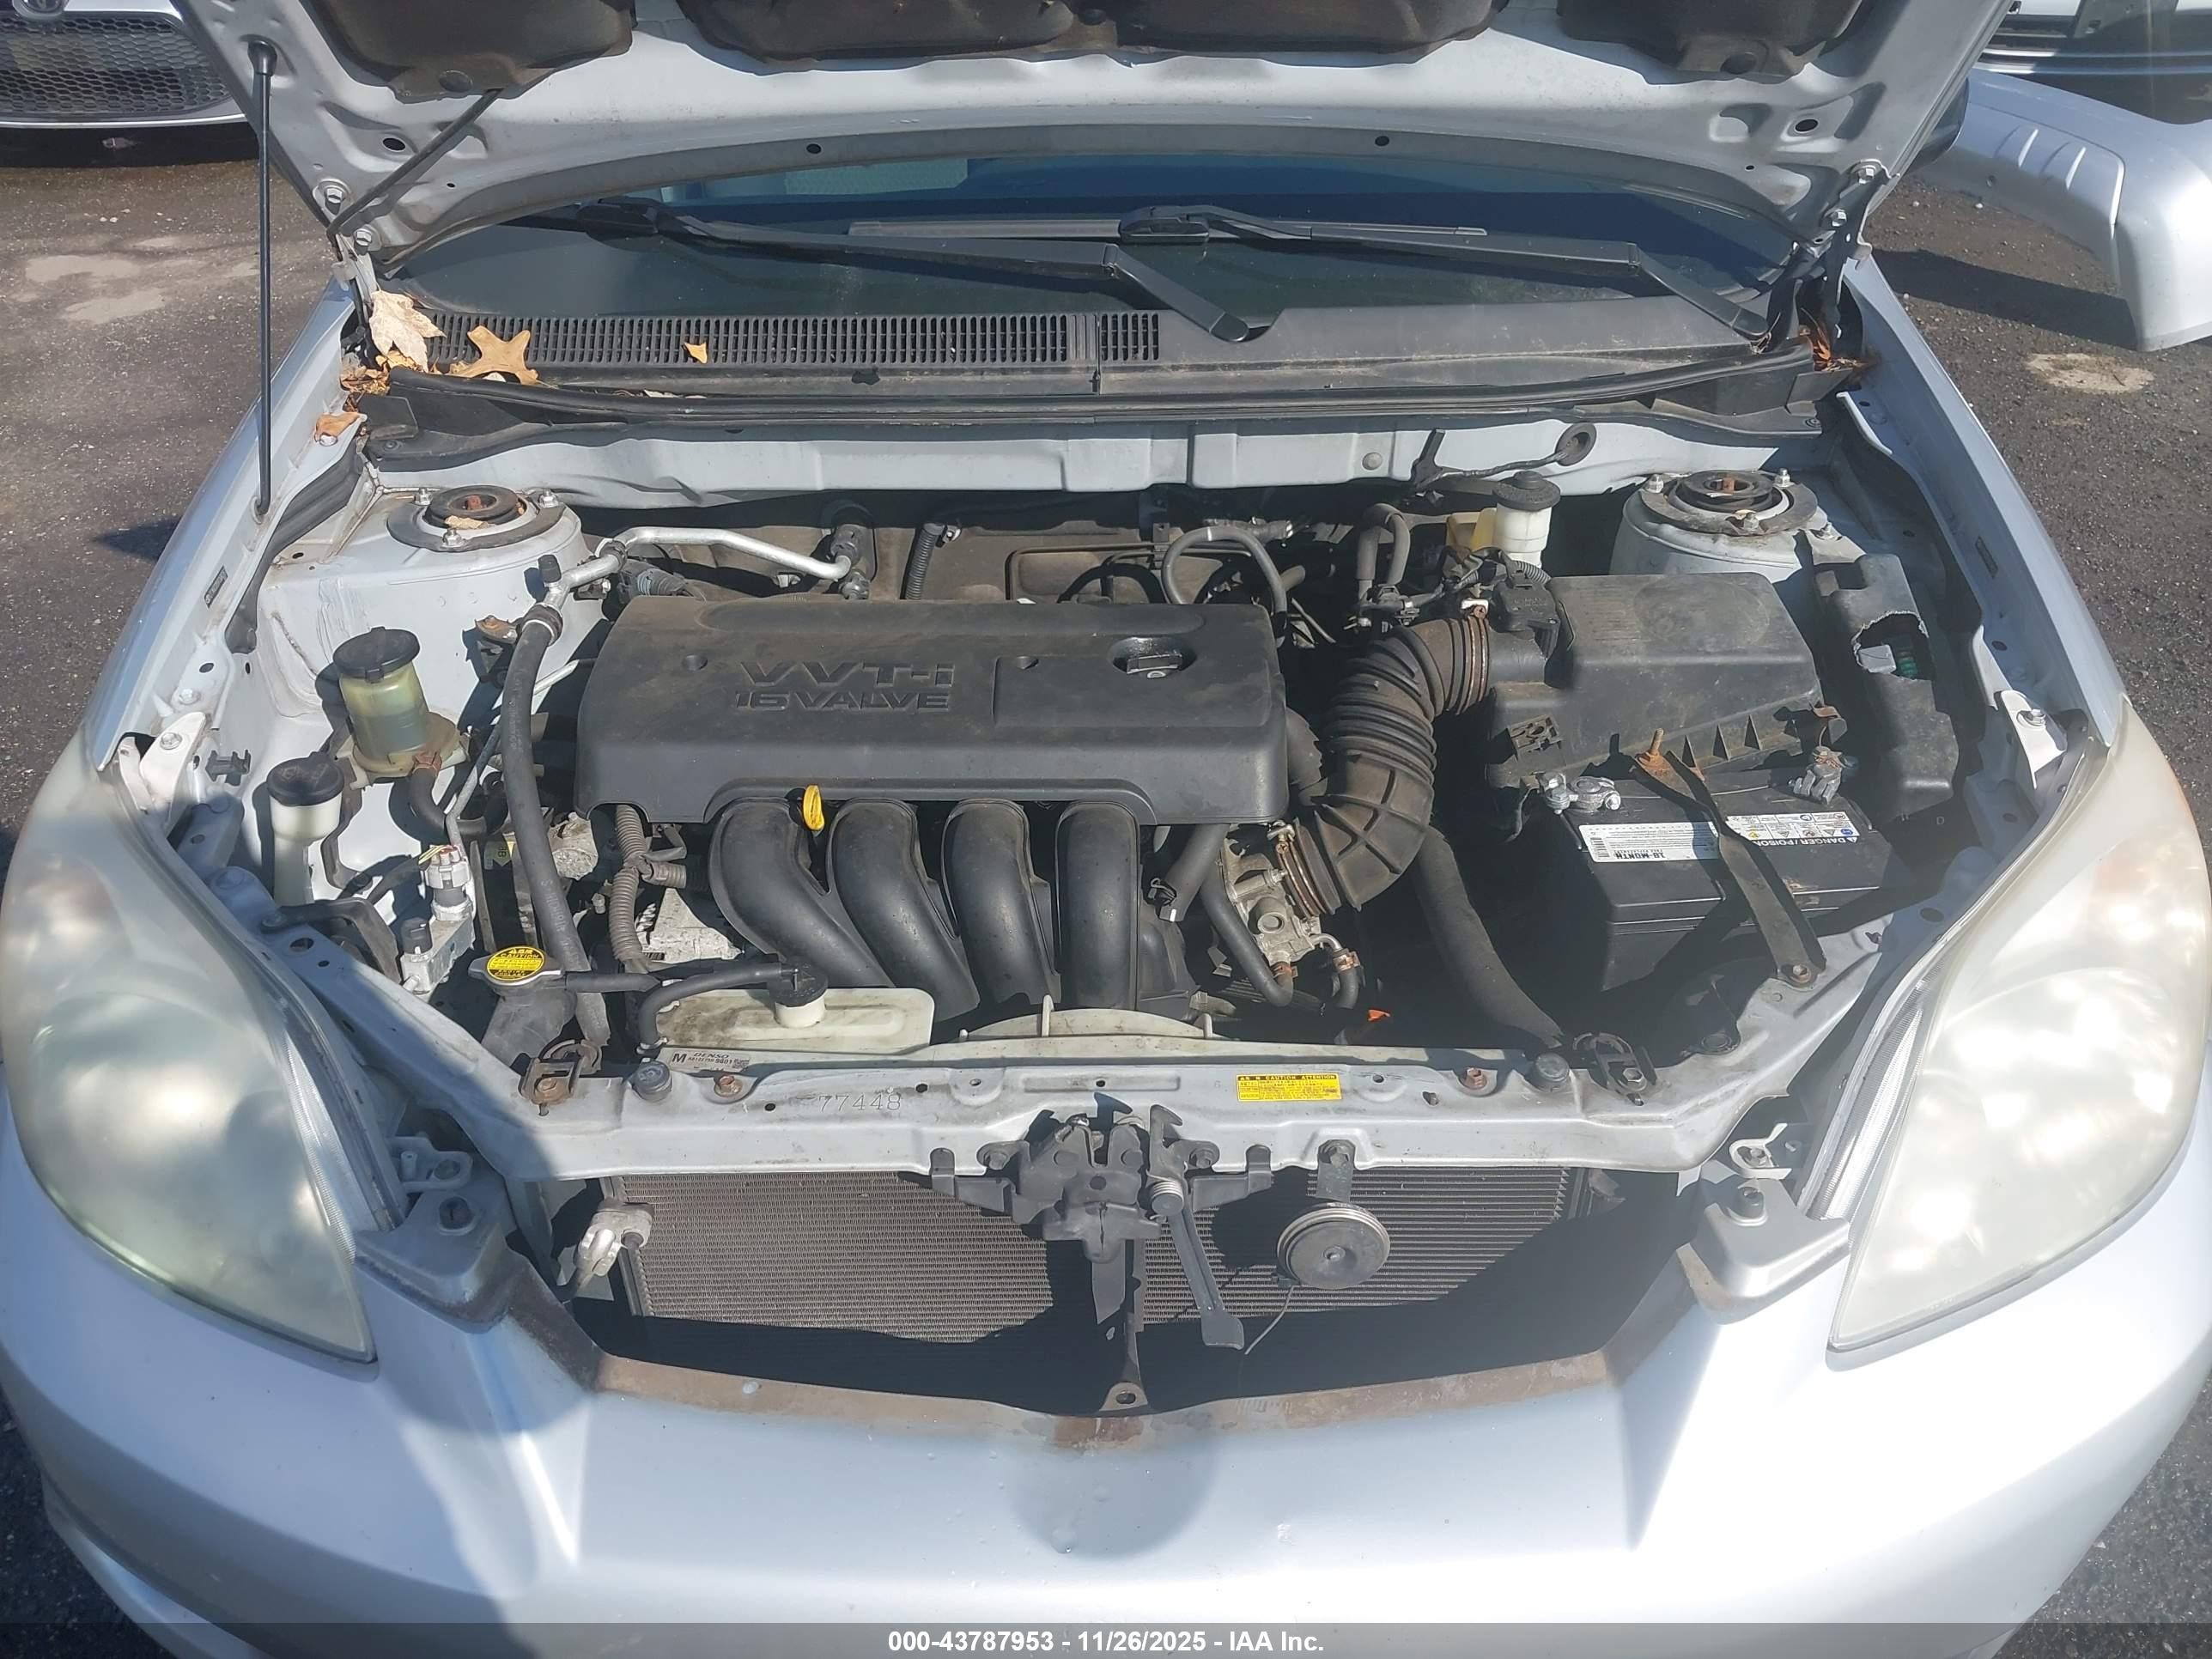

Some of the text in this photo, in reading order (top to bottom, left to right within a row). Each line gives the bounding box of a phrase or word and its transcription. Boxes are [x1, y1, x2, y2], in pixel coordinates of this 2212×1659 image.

[740, 660, 955, 687] VVT-i
[672, 1053, 687, 1063] M
[818, 1092, 901, 1112] 77448
